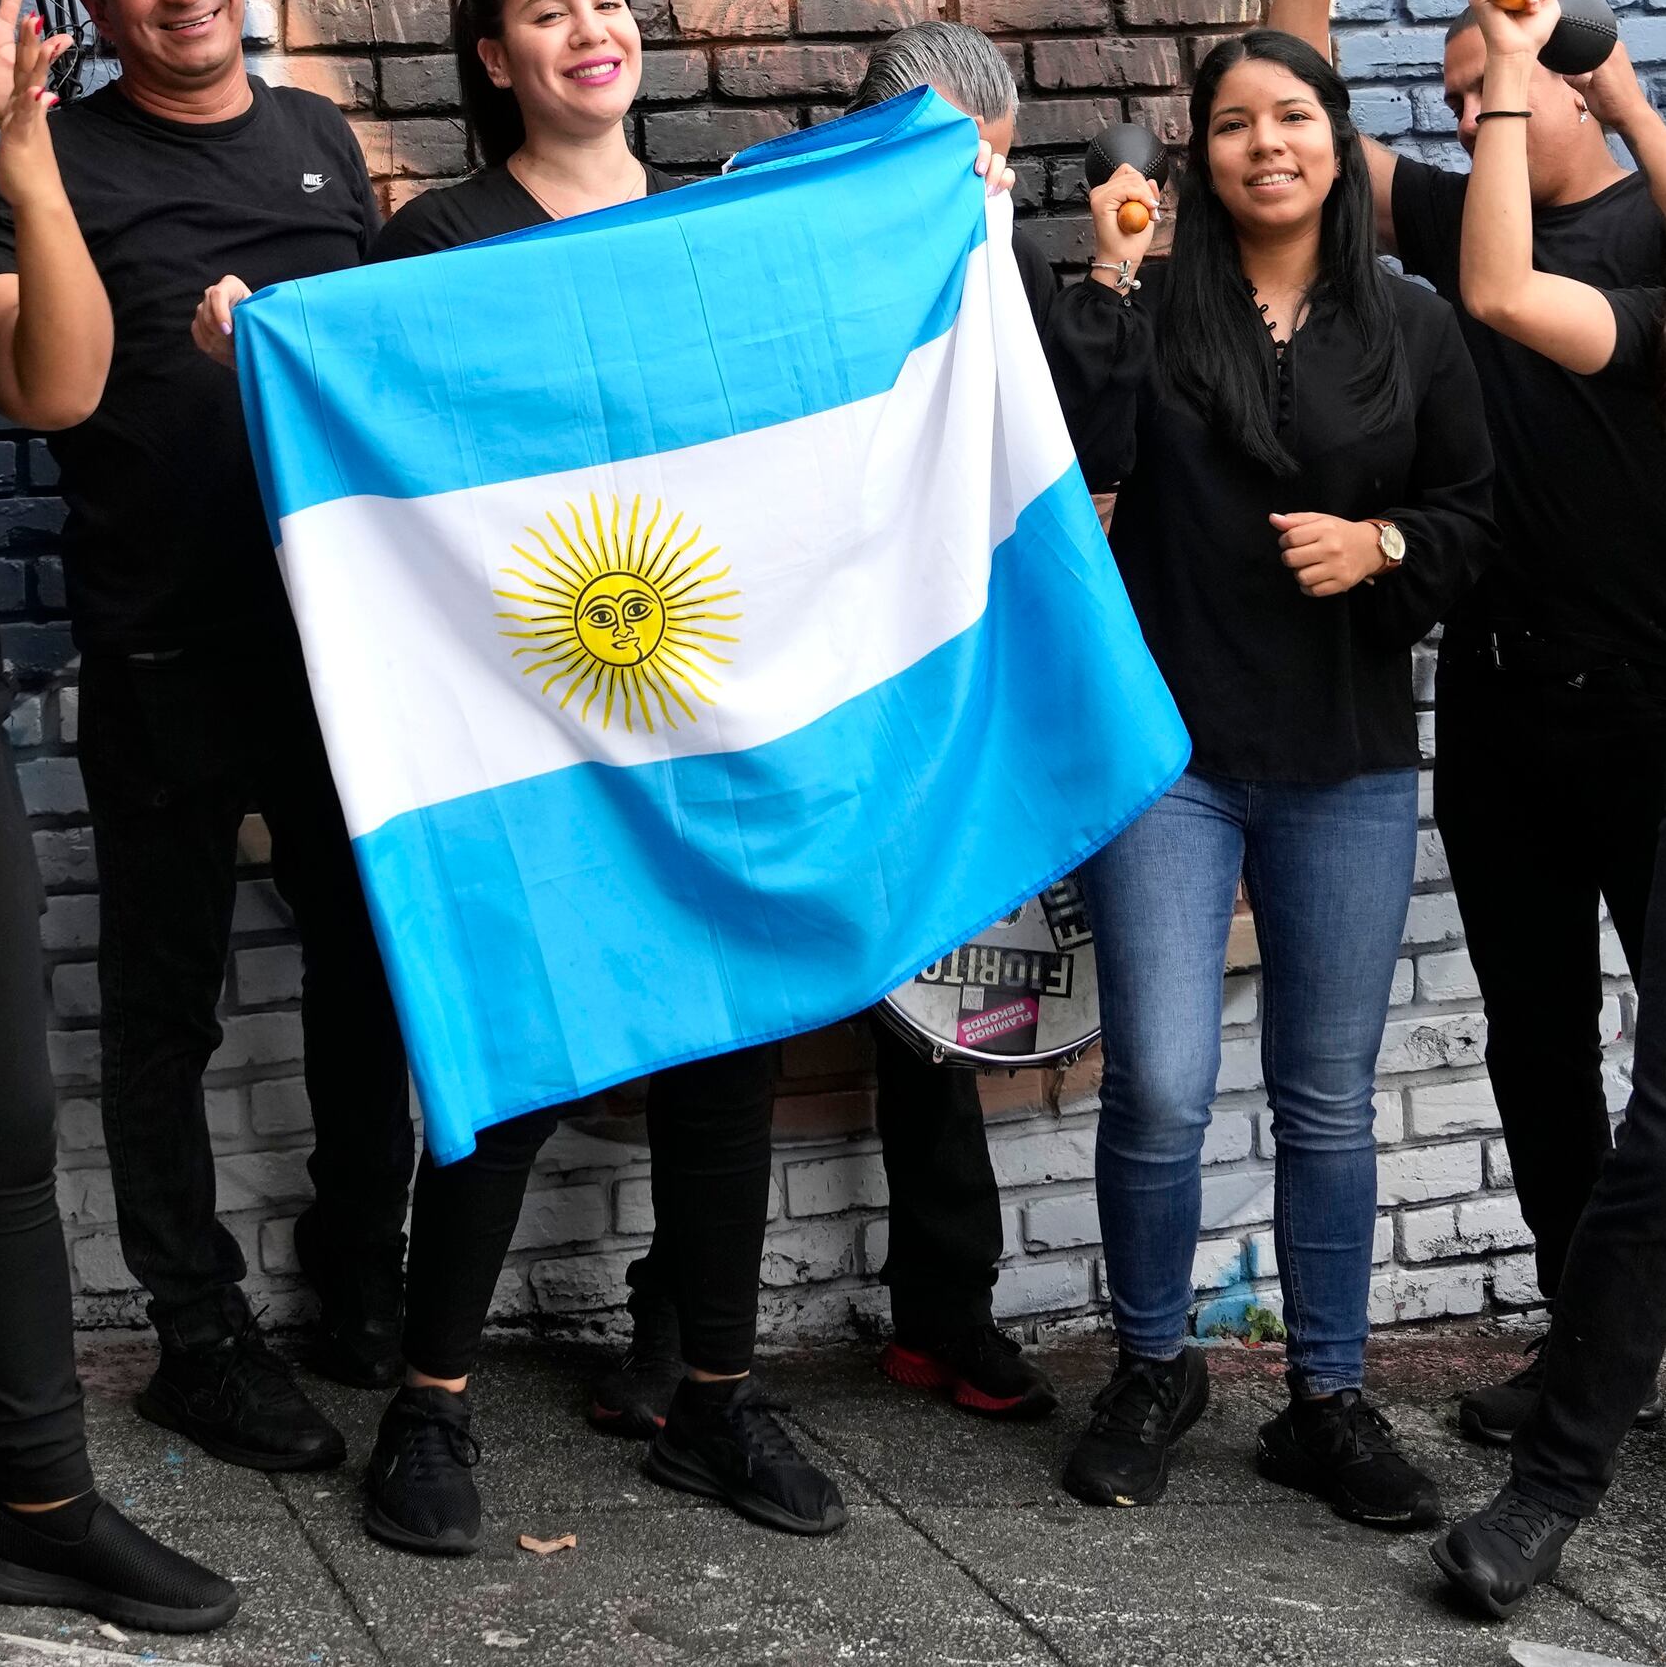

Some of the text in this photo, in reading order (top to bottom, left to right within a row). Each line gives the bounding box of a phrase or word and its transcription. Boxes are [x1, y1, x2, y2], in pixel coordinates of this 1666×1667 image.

[303, 173, 324, 186] NIKE
[962, 1001, 1026, 1034] REKORDS
[965, 1011, 1033, 1043] FLAMINGO
